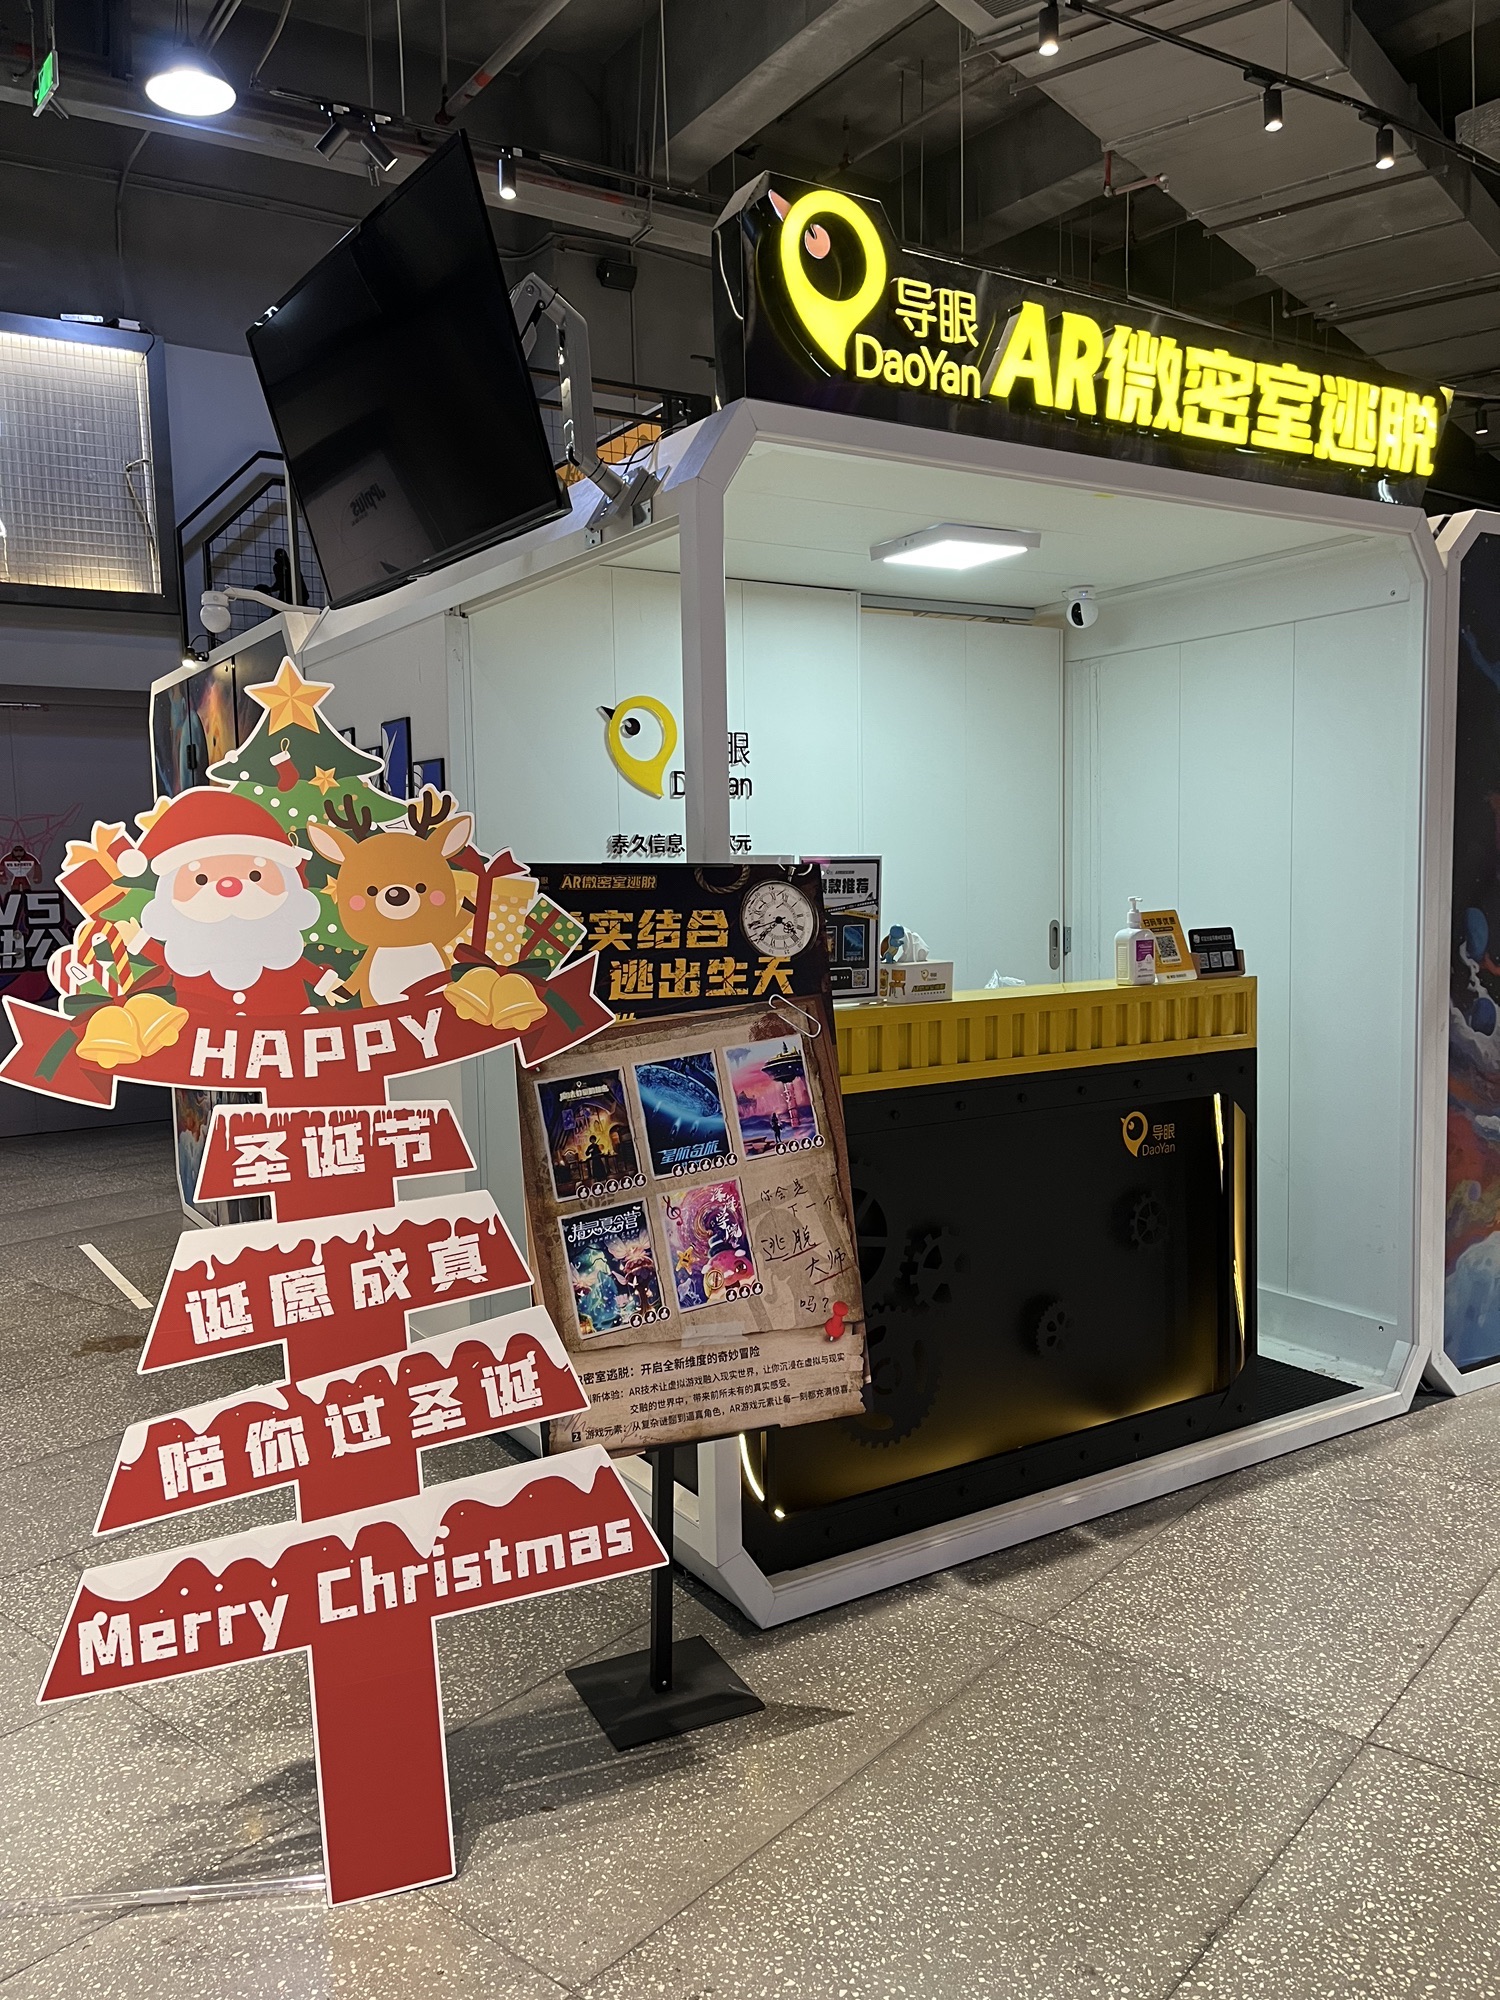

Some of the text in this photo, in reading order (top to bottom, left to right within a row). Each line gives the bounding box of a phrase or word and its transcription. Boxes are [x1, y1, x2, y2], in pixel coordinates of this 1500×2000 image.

[895, 277, 979, 347] 导眼
[855, 333, 981, 399] DaoYan
[990, 300, 1438, 477] AR微密室逃脱
[561, 875, 657, 889] AR微密室逃脱
[570, 909, 729, 951] 实结合
[609, 956, 794, 1000] 逃出生天
[190, 1008, 443, 1080] HAPPY
[231, 1114, 434, 1188] 圣诞节
[658, 1140, 722, 1165] 星航奇旅
[1142, 1142, 1176, 1156] DaoYan
[1152, 1123, 1176, 1140] 导眼
[760, 1178, 808, 1202] 你会是
[788, 1195, 836, 1218] 下一个
[568, 1208, 642, 1243] 精灵夏令营
[760, 1225, 817, 1262] 逃脱
[805, 1247, 847, 1278] 大师
[185, 1232, 488, 1346] 诞愿成真
[156, 1349, 546, 1500] 陪你过圣诞
[77, 1515, 634, 1676] Merry Christmas
